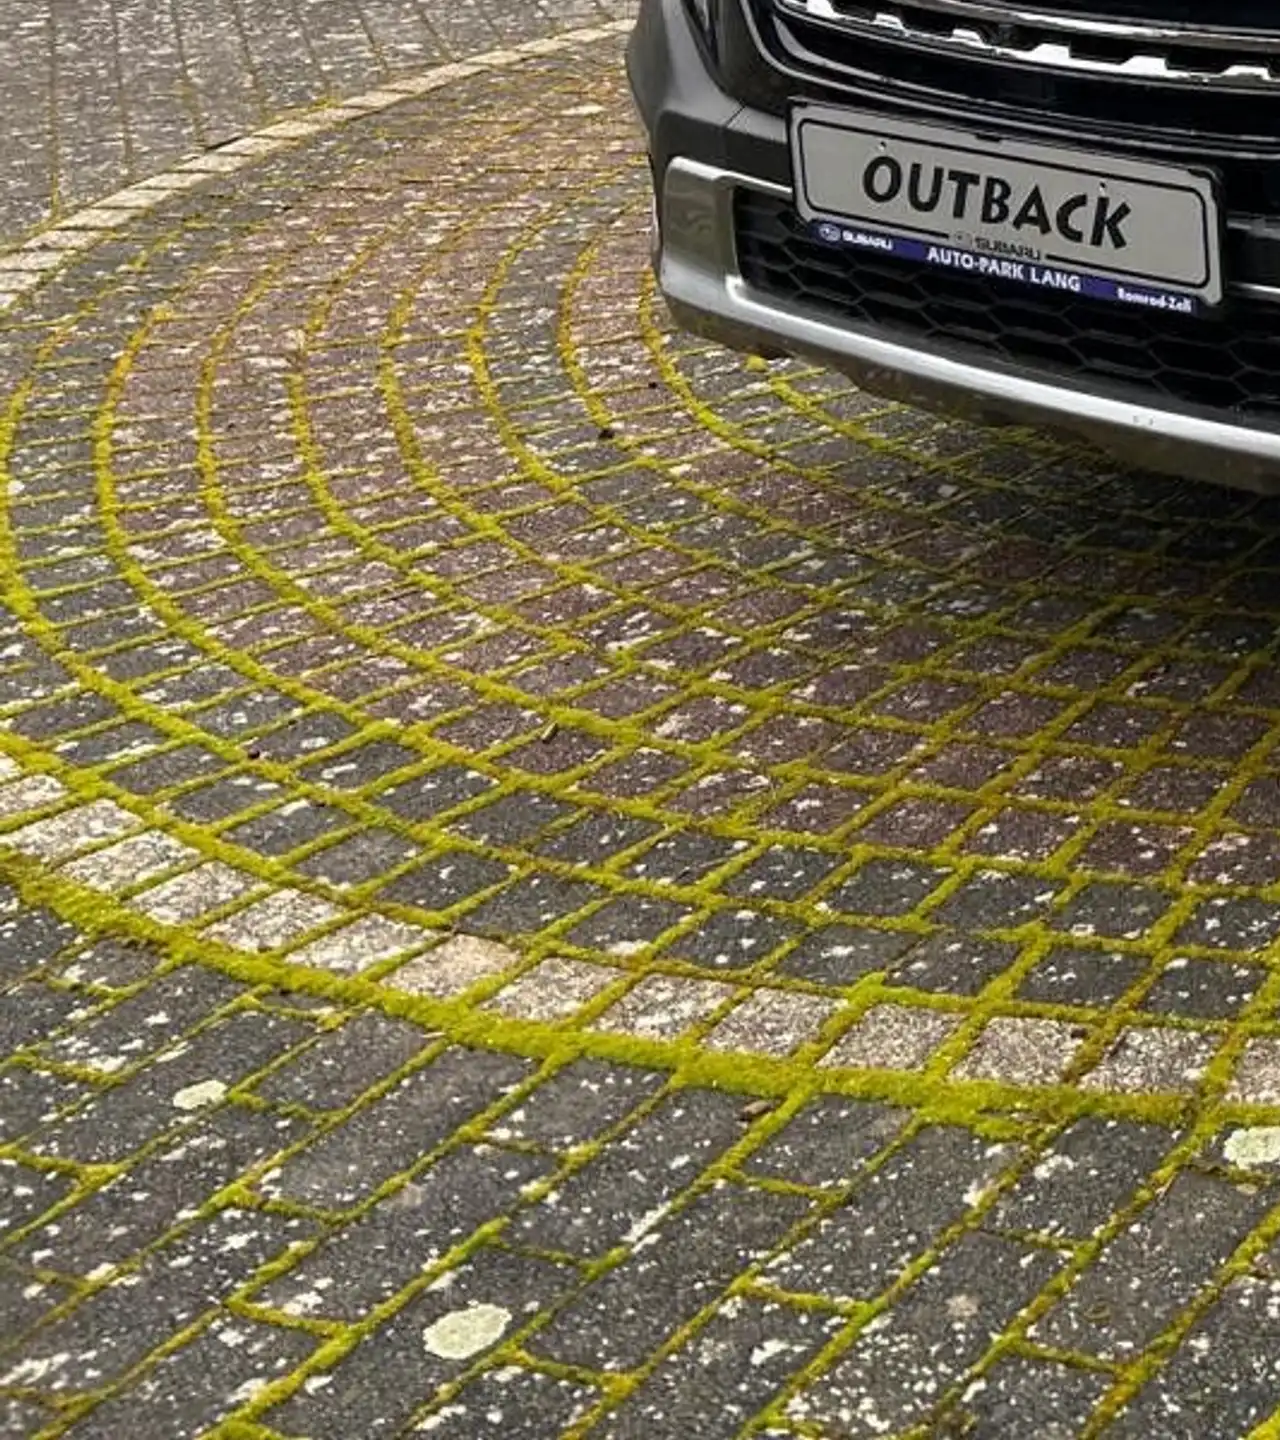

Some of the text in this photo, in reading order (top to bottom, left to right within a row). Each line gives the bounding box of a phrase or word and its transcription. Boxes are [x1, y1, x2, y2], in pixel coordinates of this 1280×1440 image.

[863, 155, 1132, 249] OUTBACK
[842, 230, 894, 251] SUBARU
[975, 237, 1041, 260] SUBARU
[927, 246, 1082, 292] AUTO-PARK LANG
